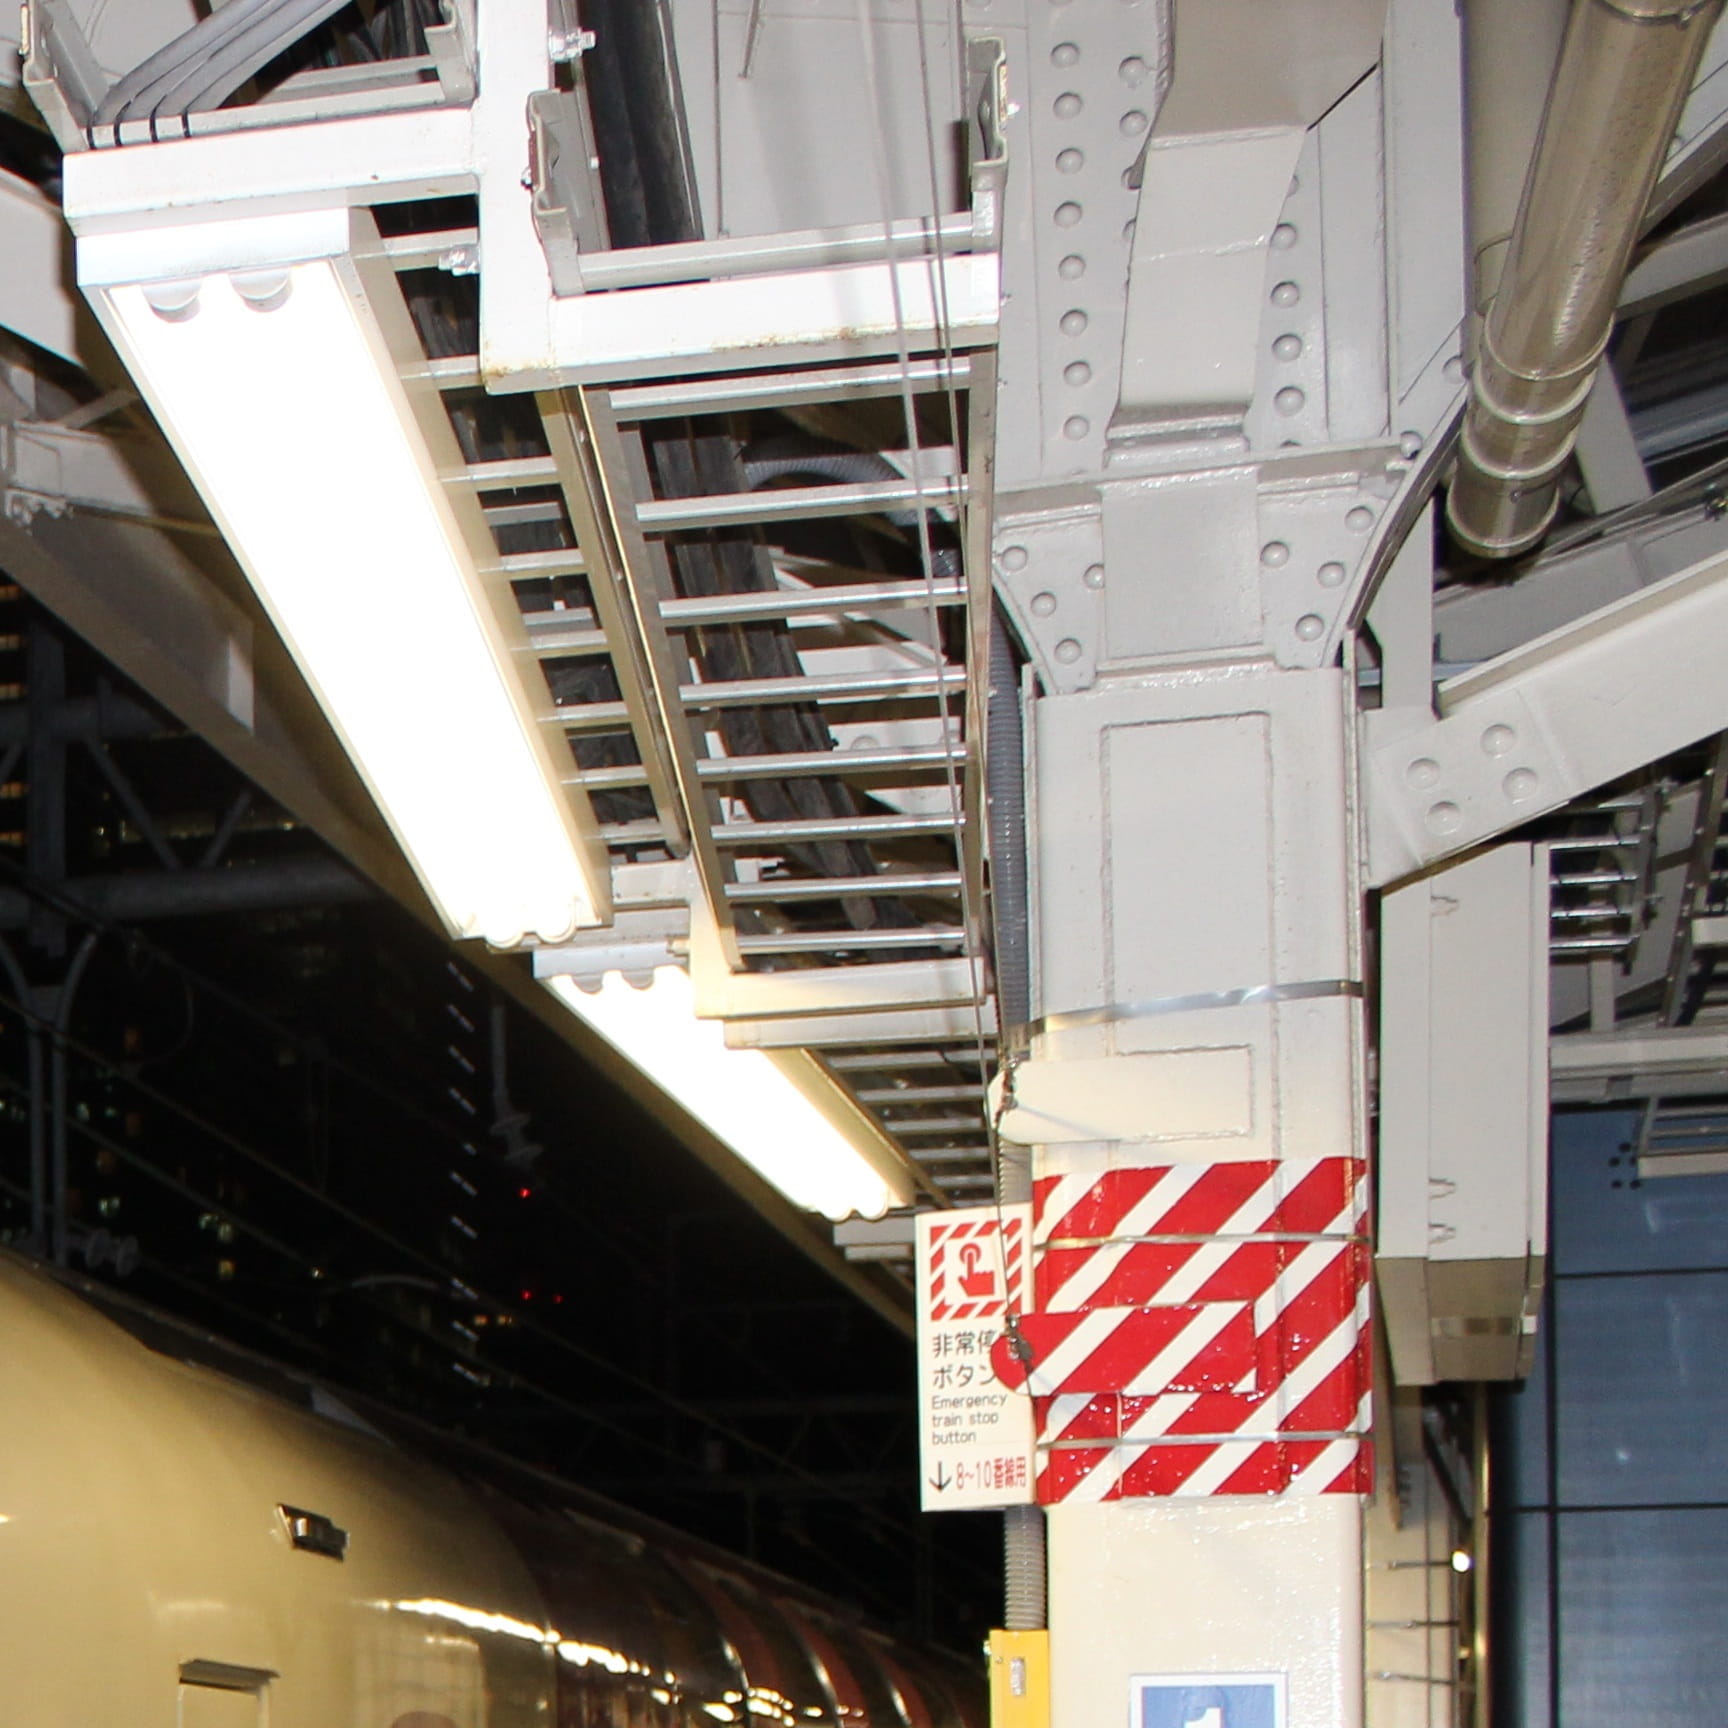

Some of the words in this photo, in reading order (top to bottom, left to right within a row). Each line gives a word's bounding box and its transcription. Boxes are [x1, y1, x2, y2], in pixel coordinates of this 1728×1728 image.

[932, 1329, 997, 1357] 非常停
[932, 1364, 996, 1389] ボタン
[931, 1392, 1008, 1412] Emergency
[932, 1413, 963, 1428] train
[969, 1411, 999, 1426] stop
[932, 1430, 977, 1446] button
